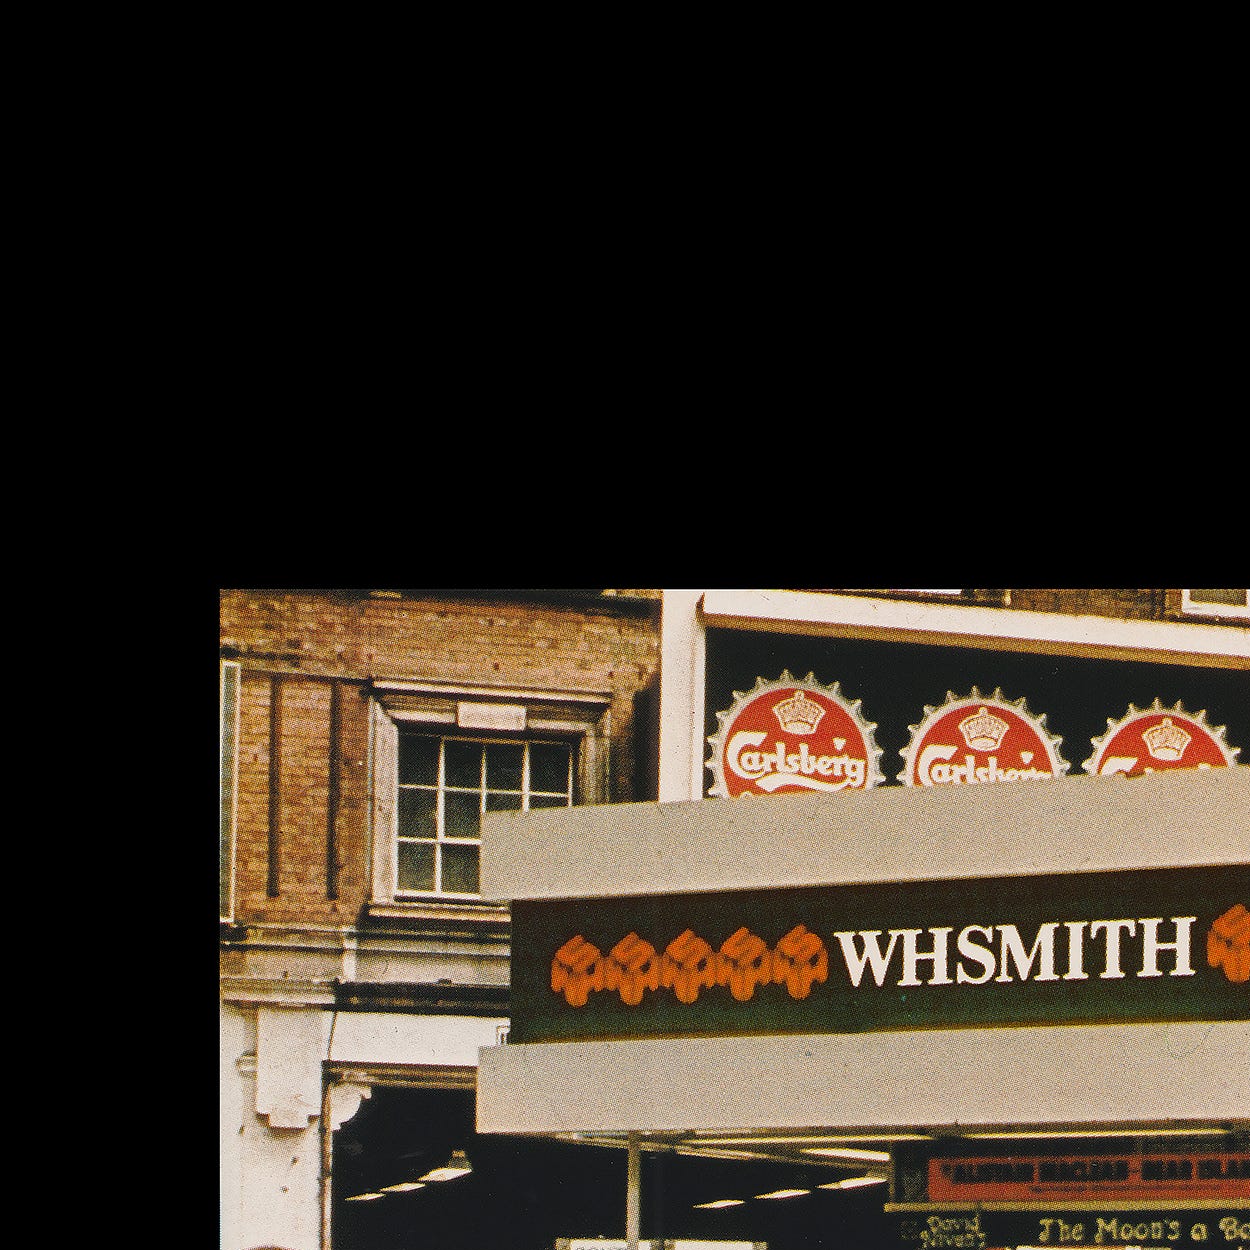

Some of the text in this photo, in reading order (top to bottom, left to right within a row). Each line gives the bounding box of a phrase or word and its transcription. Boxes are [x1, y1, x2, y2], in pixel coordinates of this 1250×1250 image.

[727, 730, 865, 790] Carlsberg
[918, 744, 1052, 787] Carlsbe
[834, 917, 1197, 987] WHSMITH
[1039, 1218, 1083, 1242] The
[1095, 1217, 1180, 1243] Moon's
[1190, 1222, 1208, 1241] a
